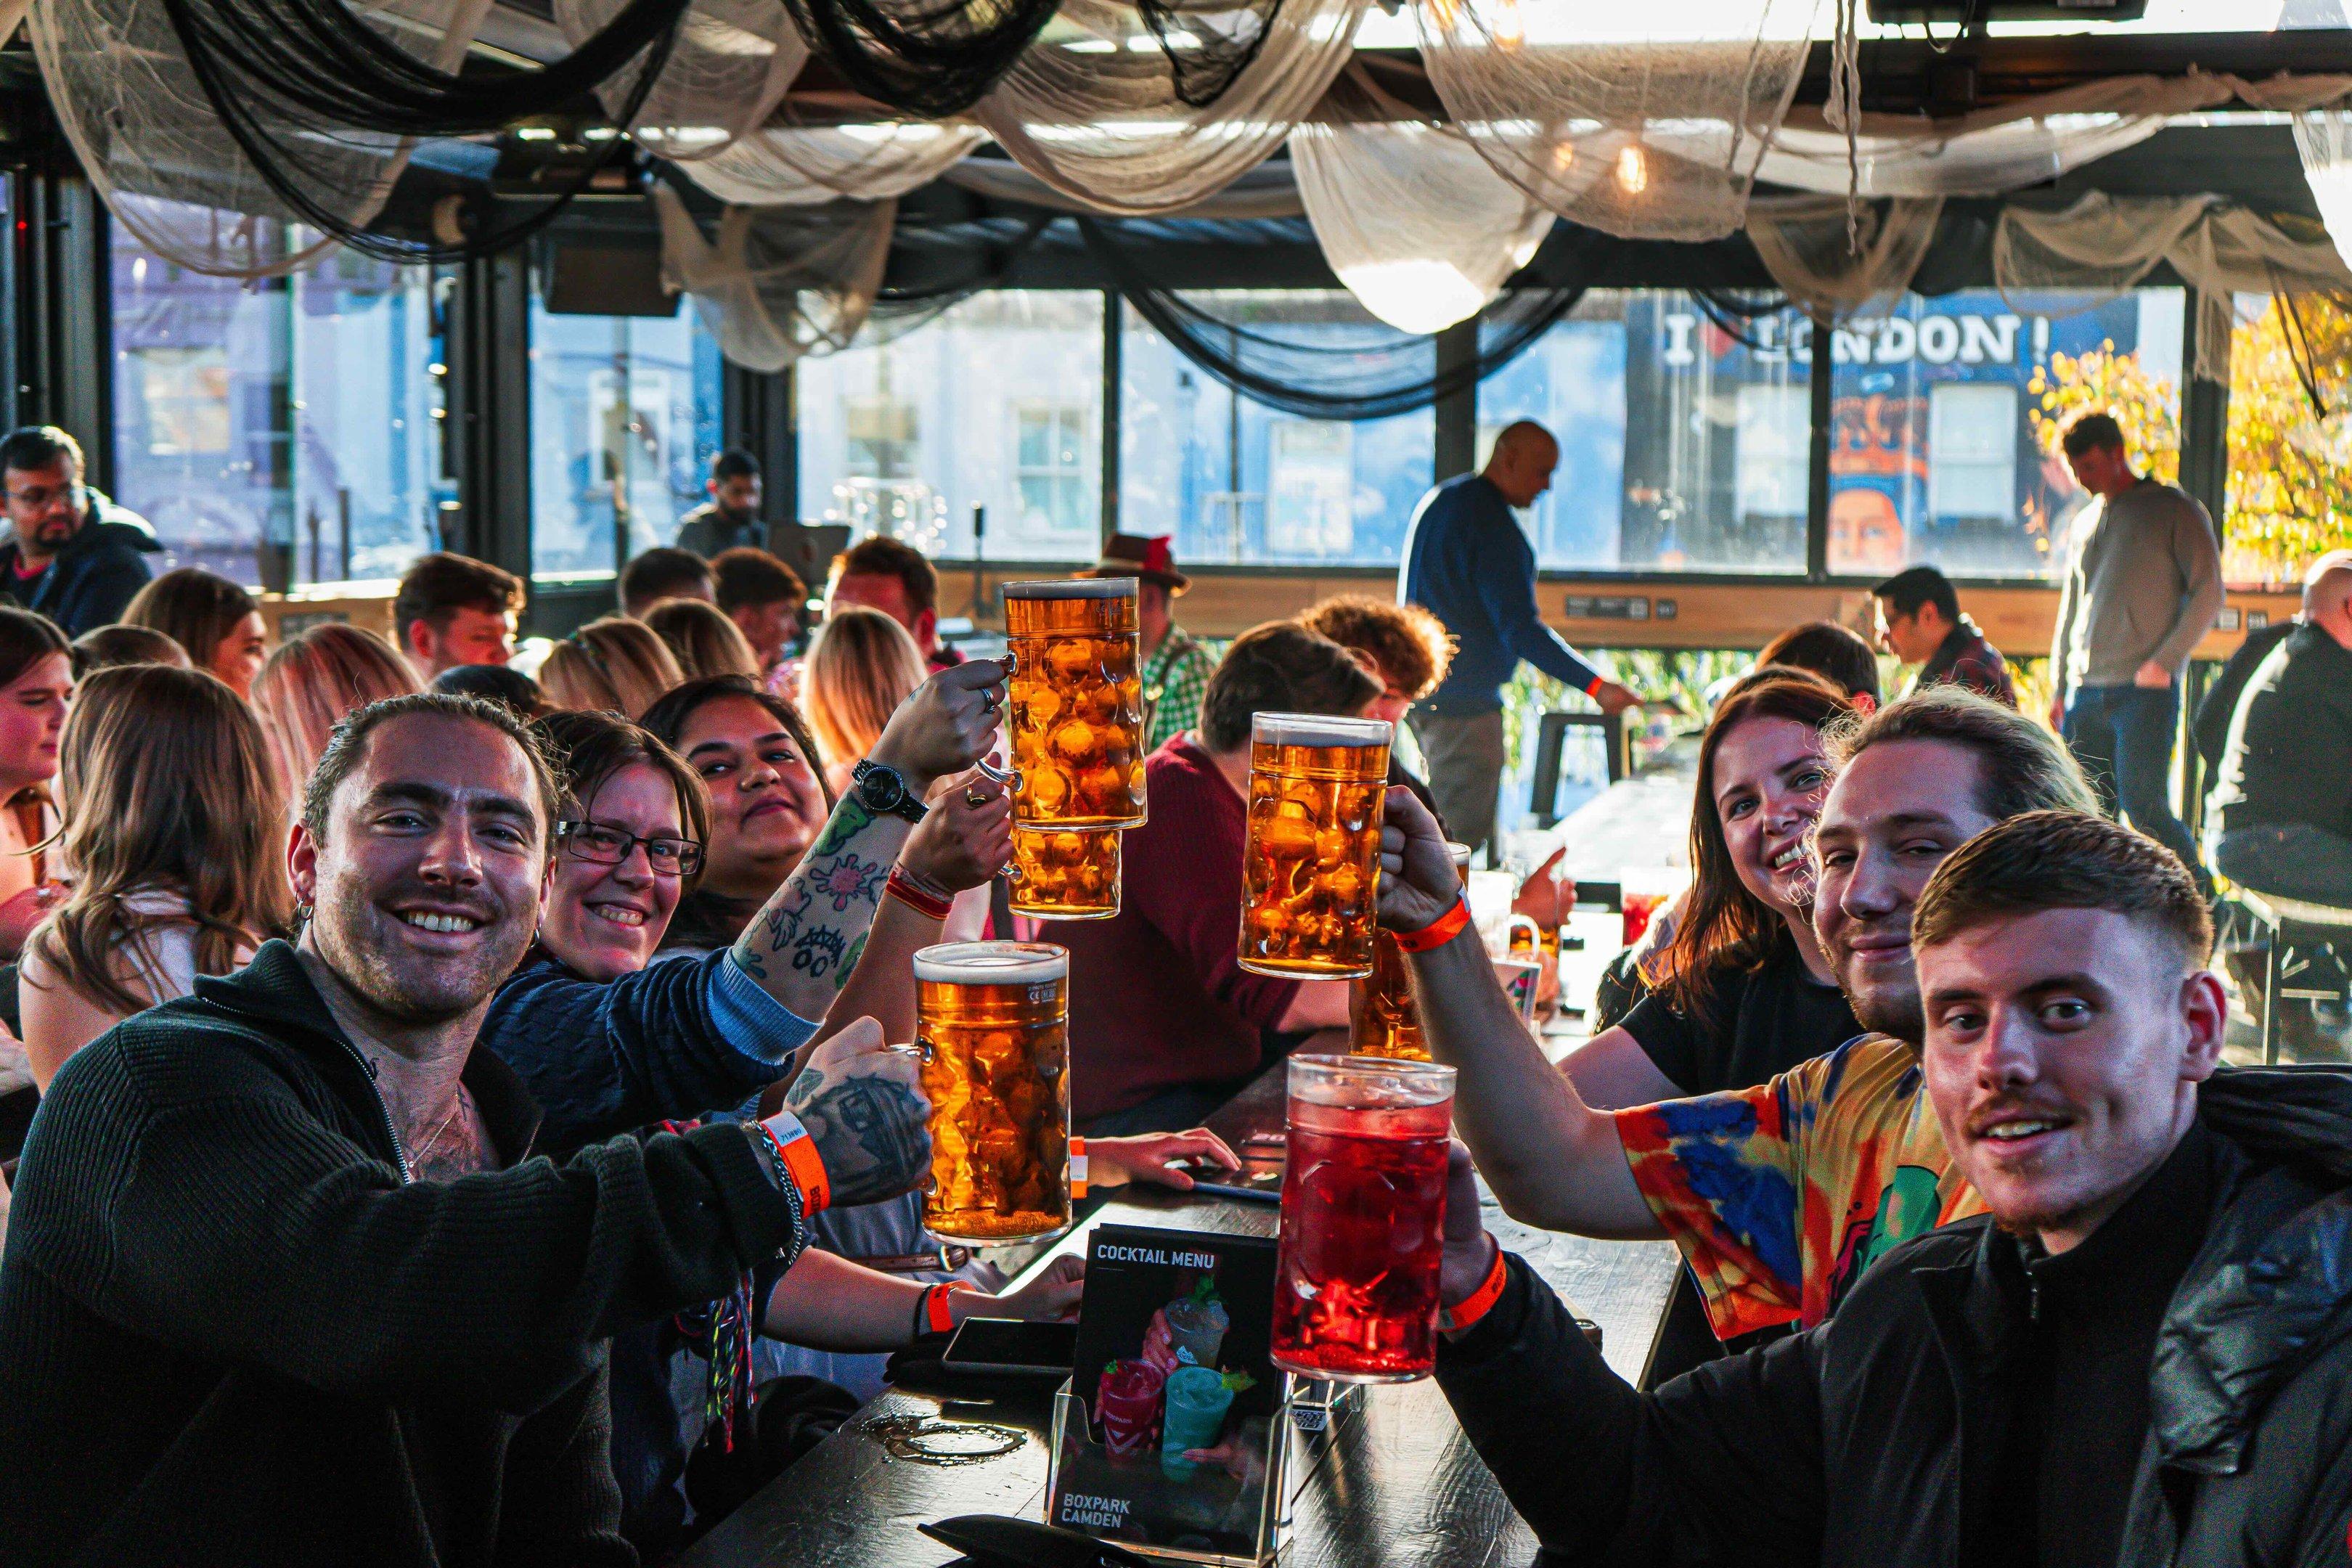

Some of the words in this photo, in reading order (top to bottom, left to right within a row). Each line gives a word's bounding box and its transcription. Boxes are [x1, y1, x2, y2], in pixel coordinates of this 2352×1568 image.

[1665, 313, 1696, 364] I
[1098, 1244, 1168, 1265] COCKTAIL
[1172, 1251, 1214, 1269] MENU
[1063, 1493, 1130, 1514] BOXPARK
[1061, 1508, 1122, 1528] CAMDEN
